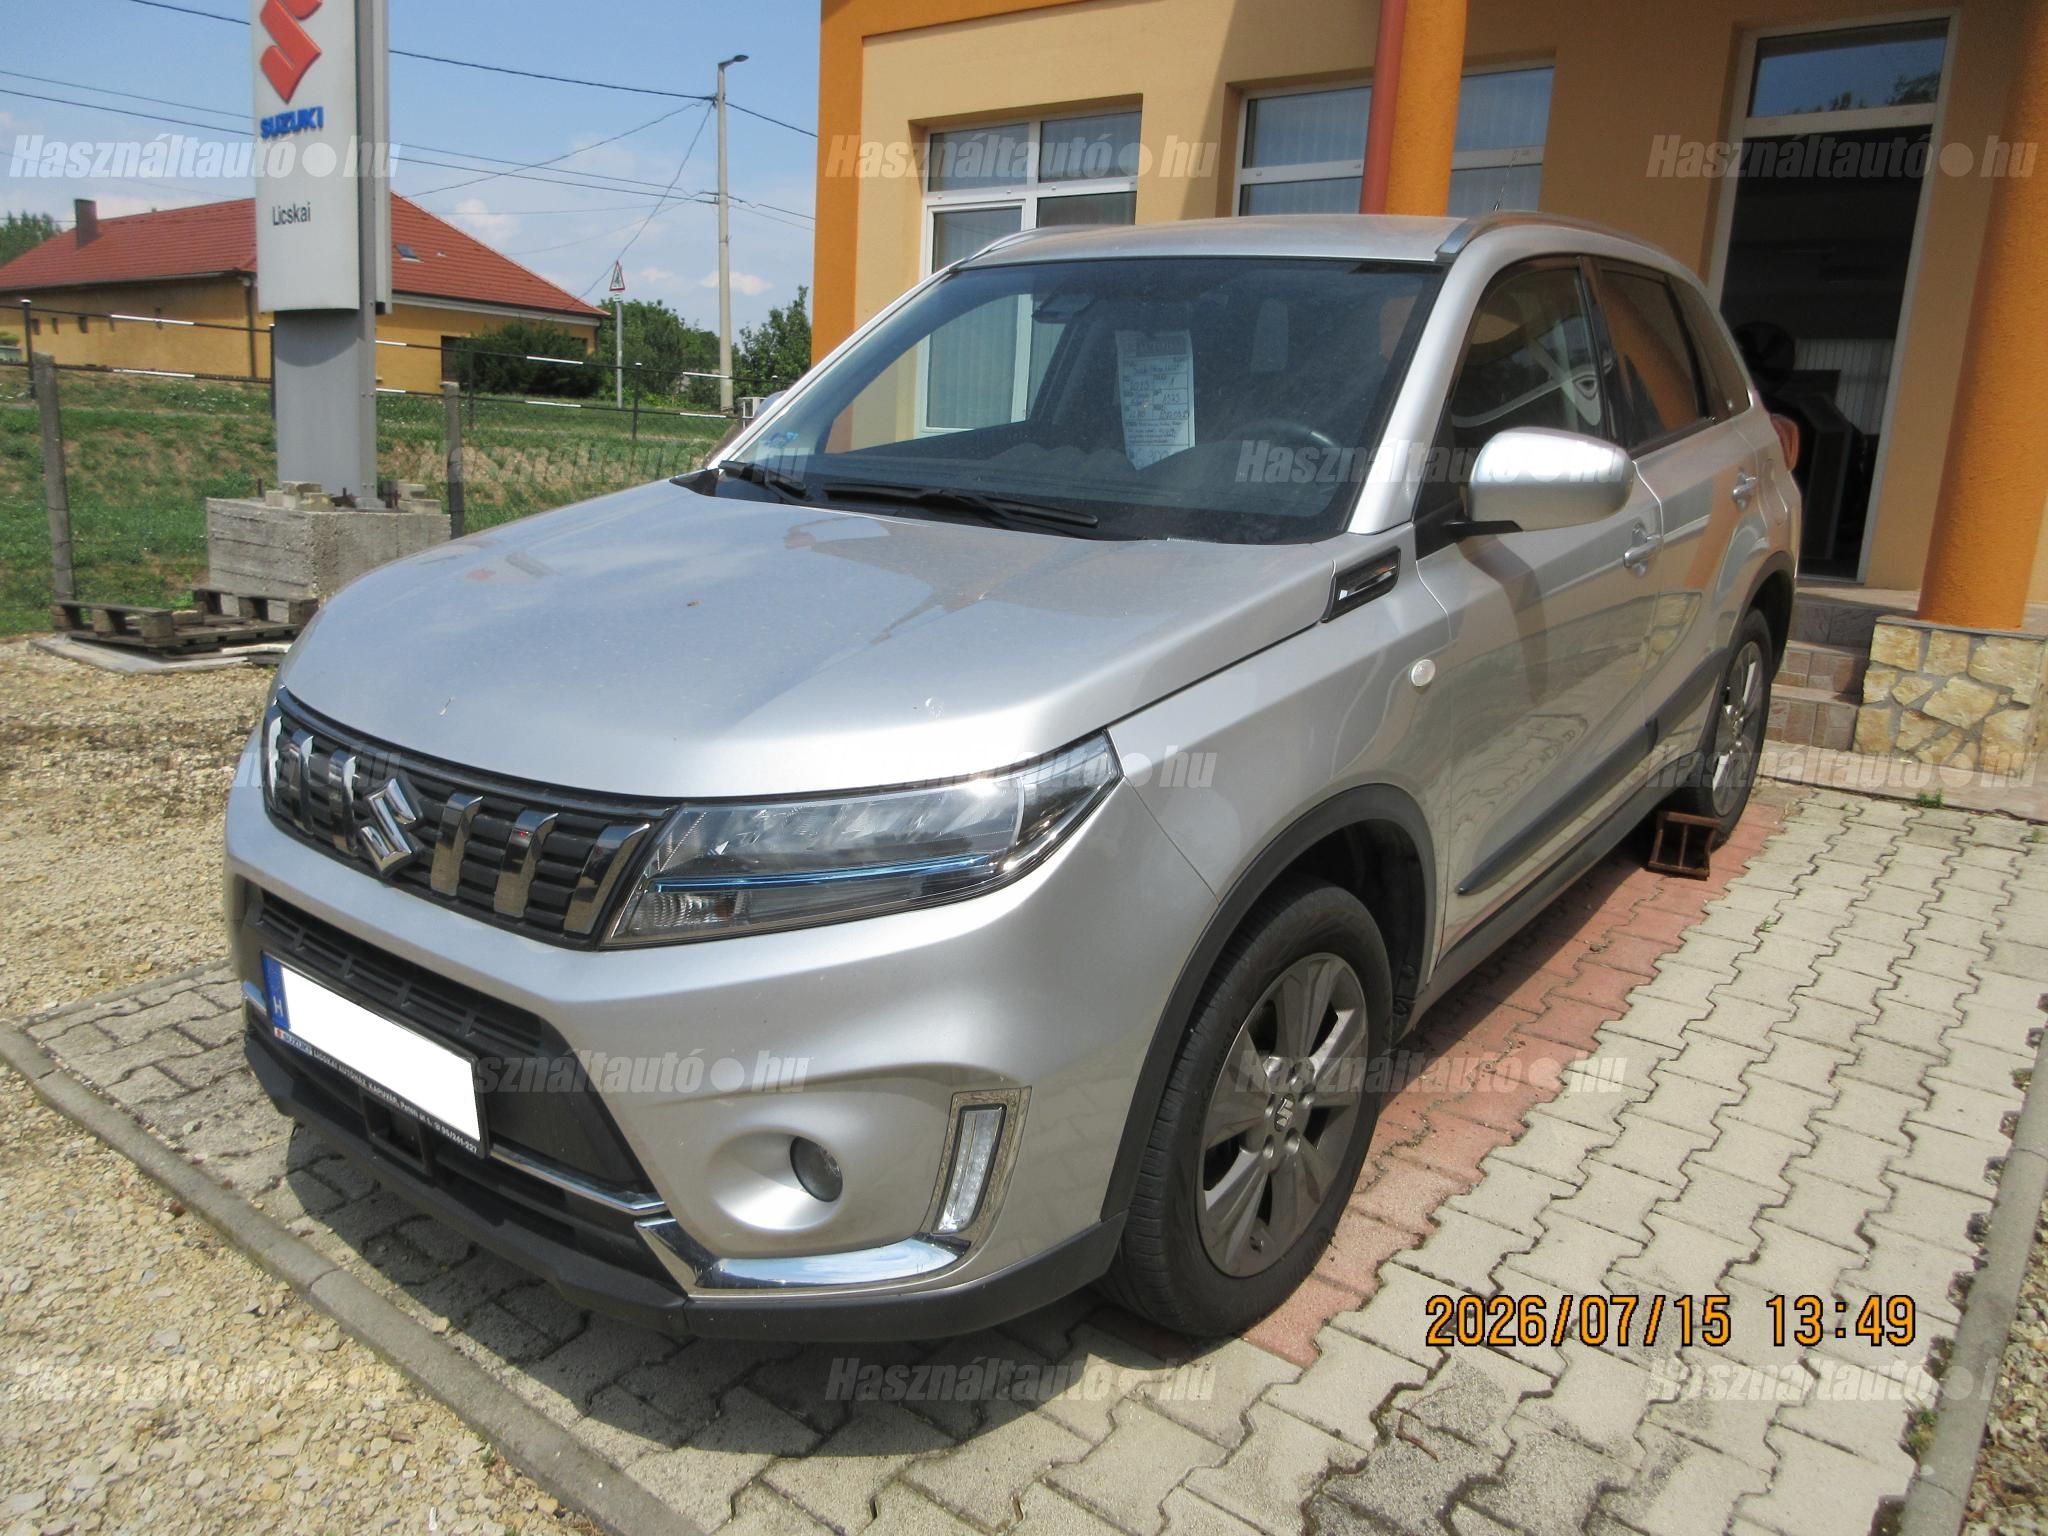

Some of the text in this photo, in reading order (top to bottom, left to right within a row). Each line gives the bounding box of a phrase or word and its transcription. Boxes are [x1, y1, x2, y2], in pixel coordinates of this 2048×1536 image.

[260, 106, 324, 140] SUZUKI
[272, 202, 311, 226] Licskai
[273, 996, 284, 1018] H
